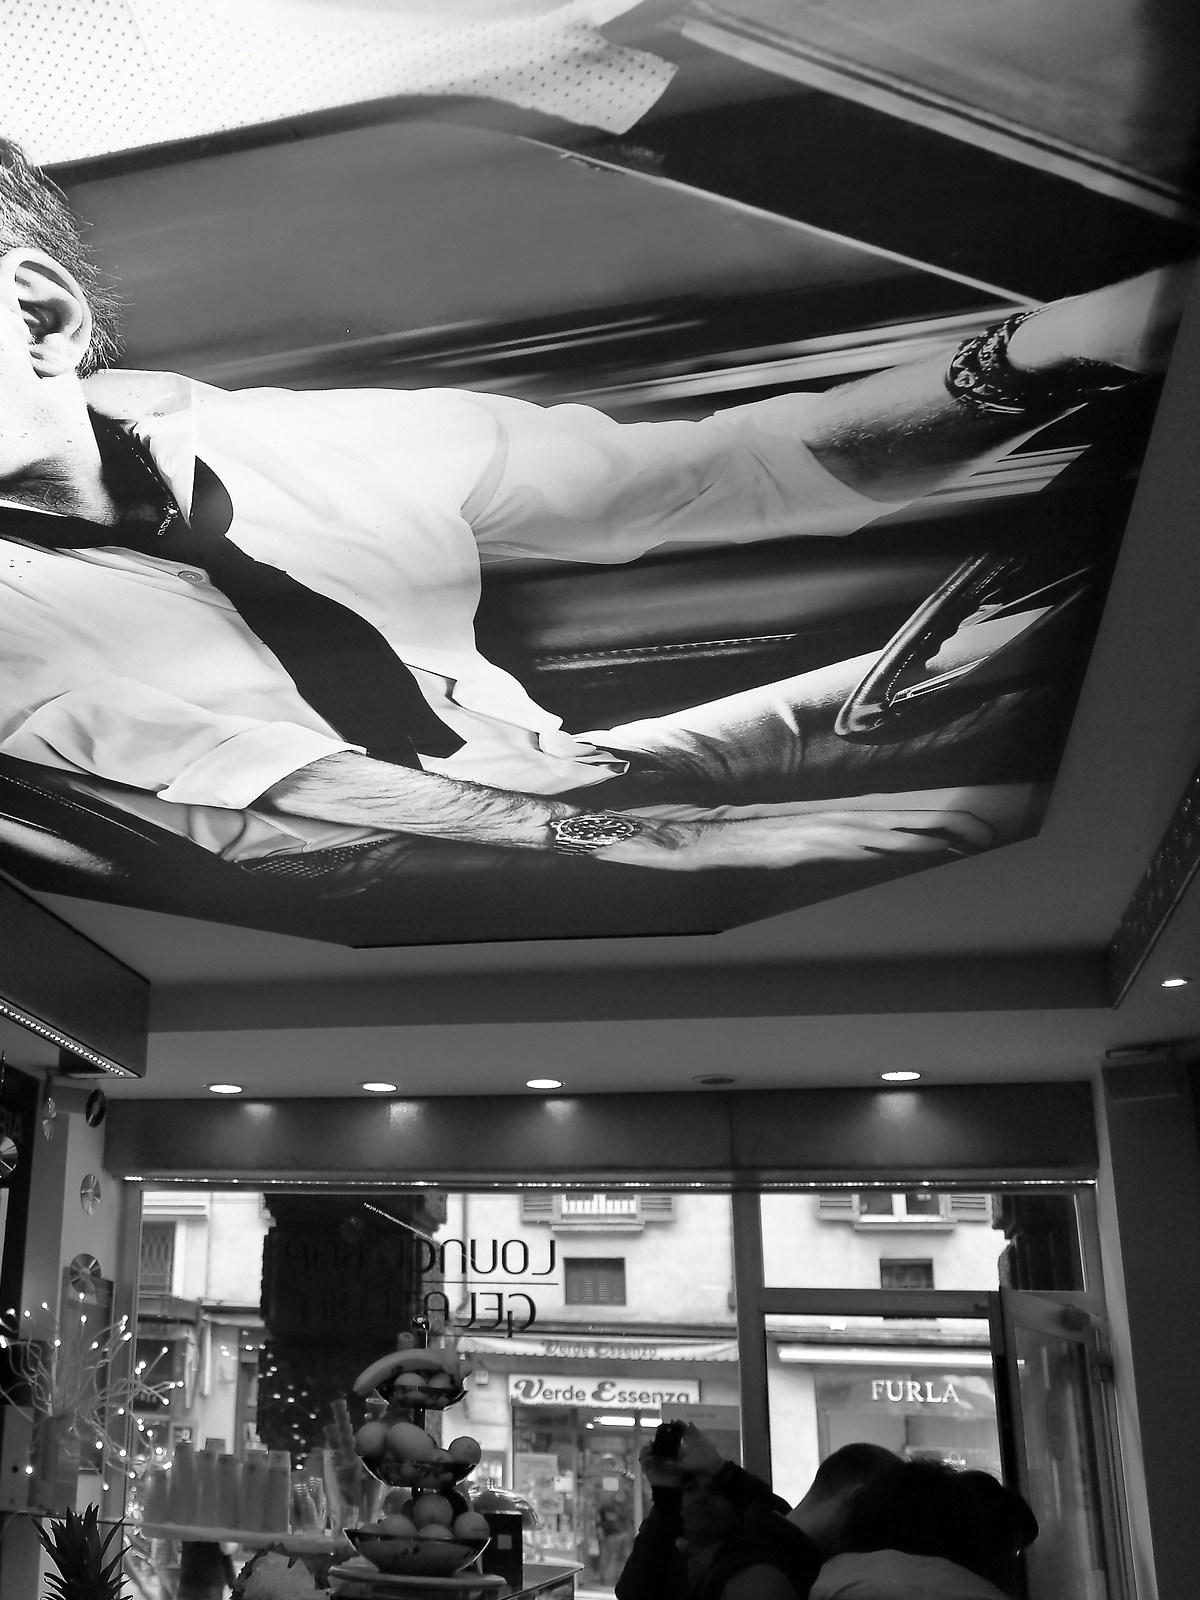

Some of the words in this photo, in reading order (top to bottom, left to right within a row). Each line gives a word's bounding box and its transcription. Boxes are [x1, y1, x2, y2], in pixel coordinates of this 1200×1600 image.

[514, 1378, 586, 1402] Verde
[590, 1380, 690, 1405] Essenza
[870, 1379, 961, 1404] FURLA
